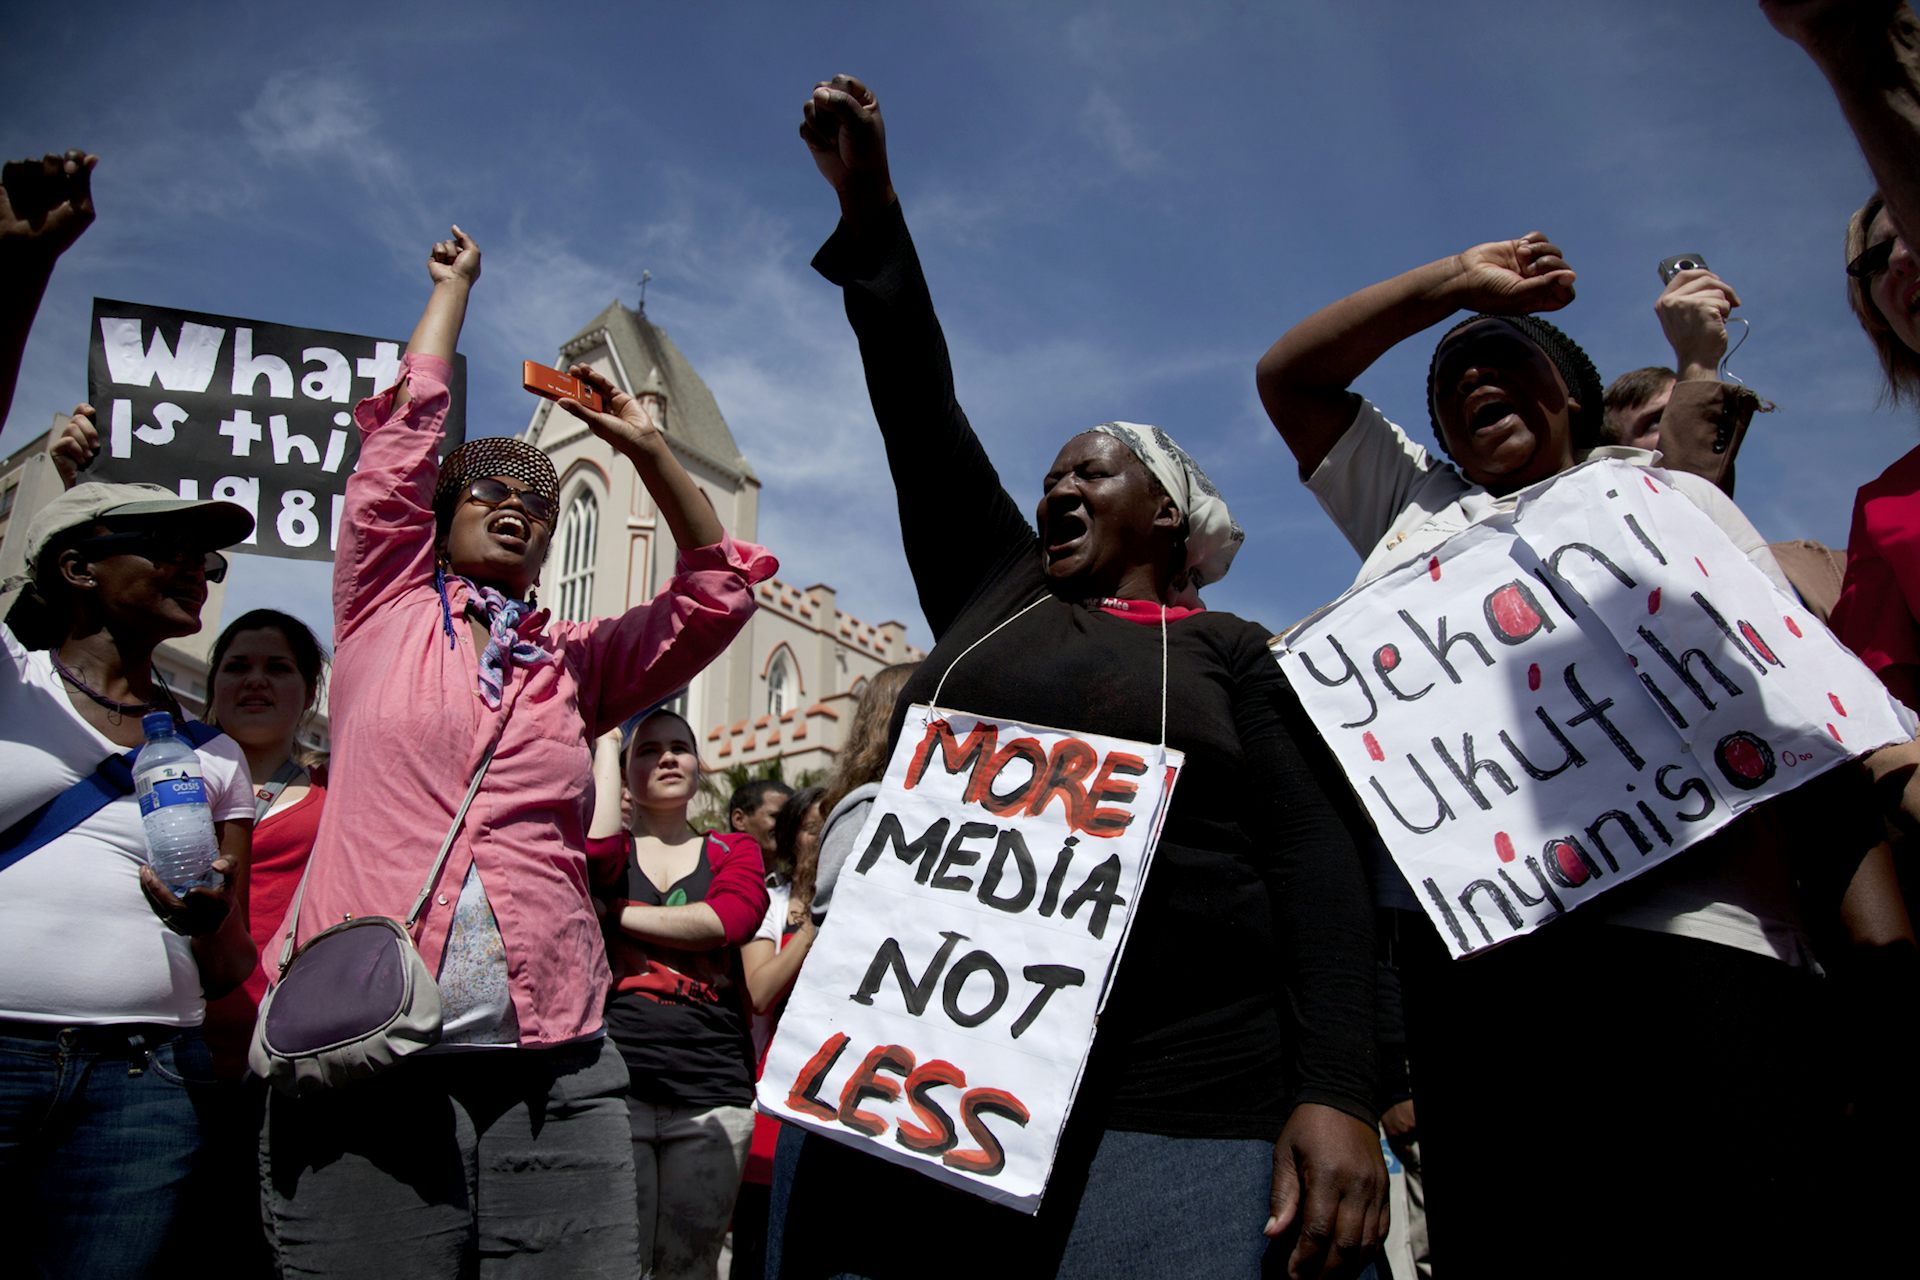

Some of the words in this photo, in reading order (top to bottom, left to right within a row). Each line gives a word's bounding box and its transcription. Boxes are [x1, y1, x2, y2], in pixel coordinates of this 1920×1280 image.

[100, 317, 402, 405] What
[219, 409, 361, 474] thi
[1299, 488, 1668, 729] Yekani
[903, 718, 1148, 838] MORE
[849, 930, 1086, 1040] NOT
[785, 1031, 1031, 1177] LESS
